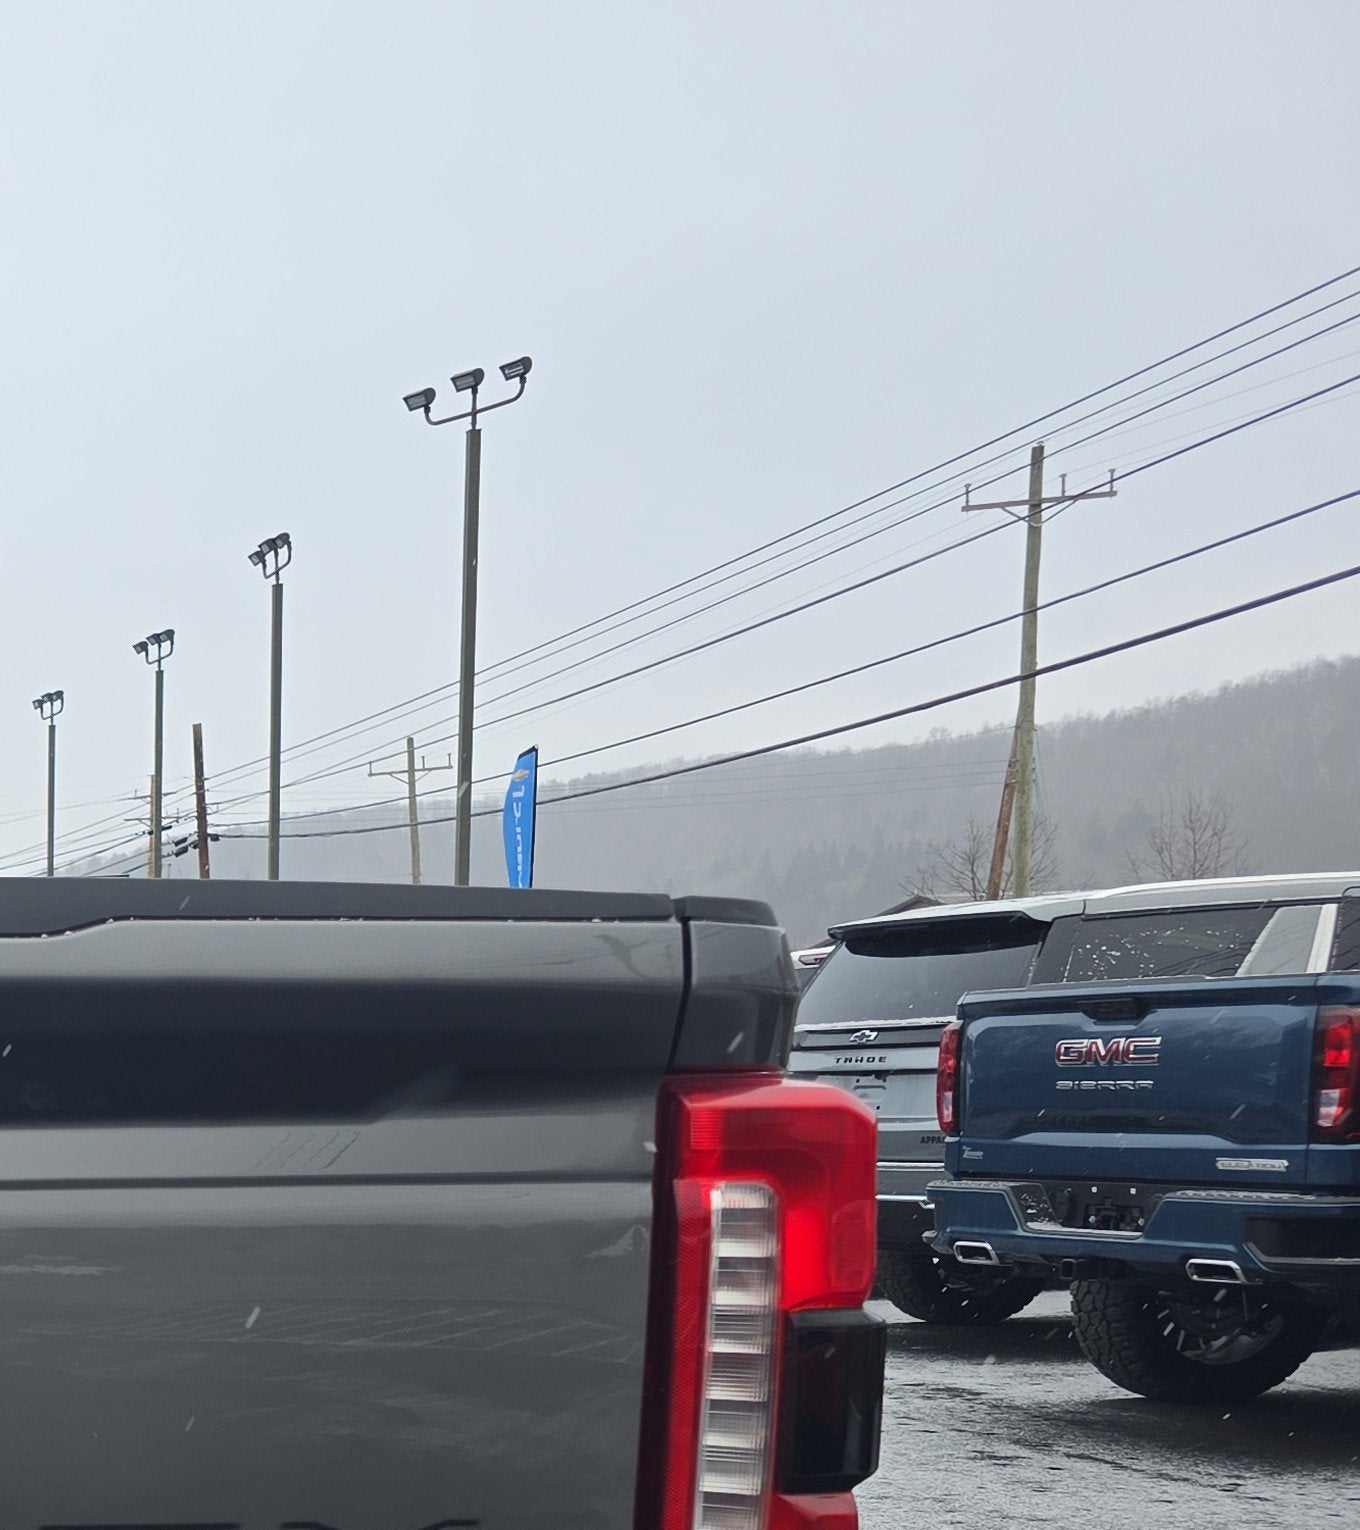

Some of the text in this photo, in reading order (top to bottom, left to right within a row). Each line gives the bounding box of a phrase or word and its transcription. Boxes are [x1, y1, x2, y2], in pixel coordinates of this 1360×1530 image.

[1055, 1036, 1162, 1067] GMC
[834, 1056, 887, 1064] TAHOE
[1055, 1080, 1154, 1091] SIERRA
